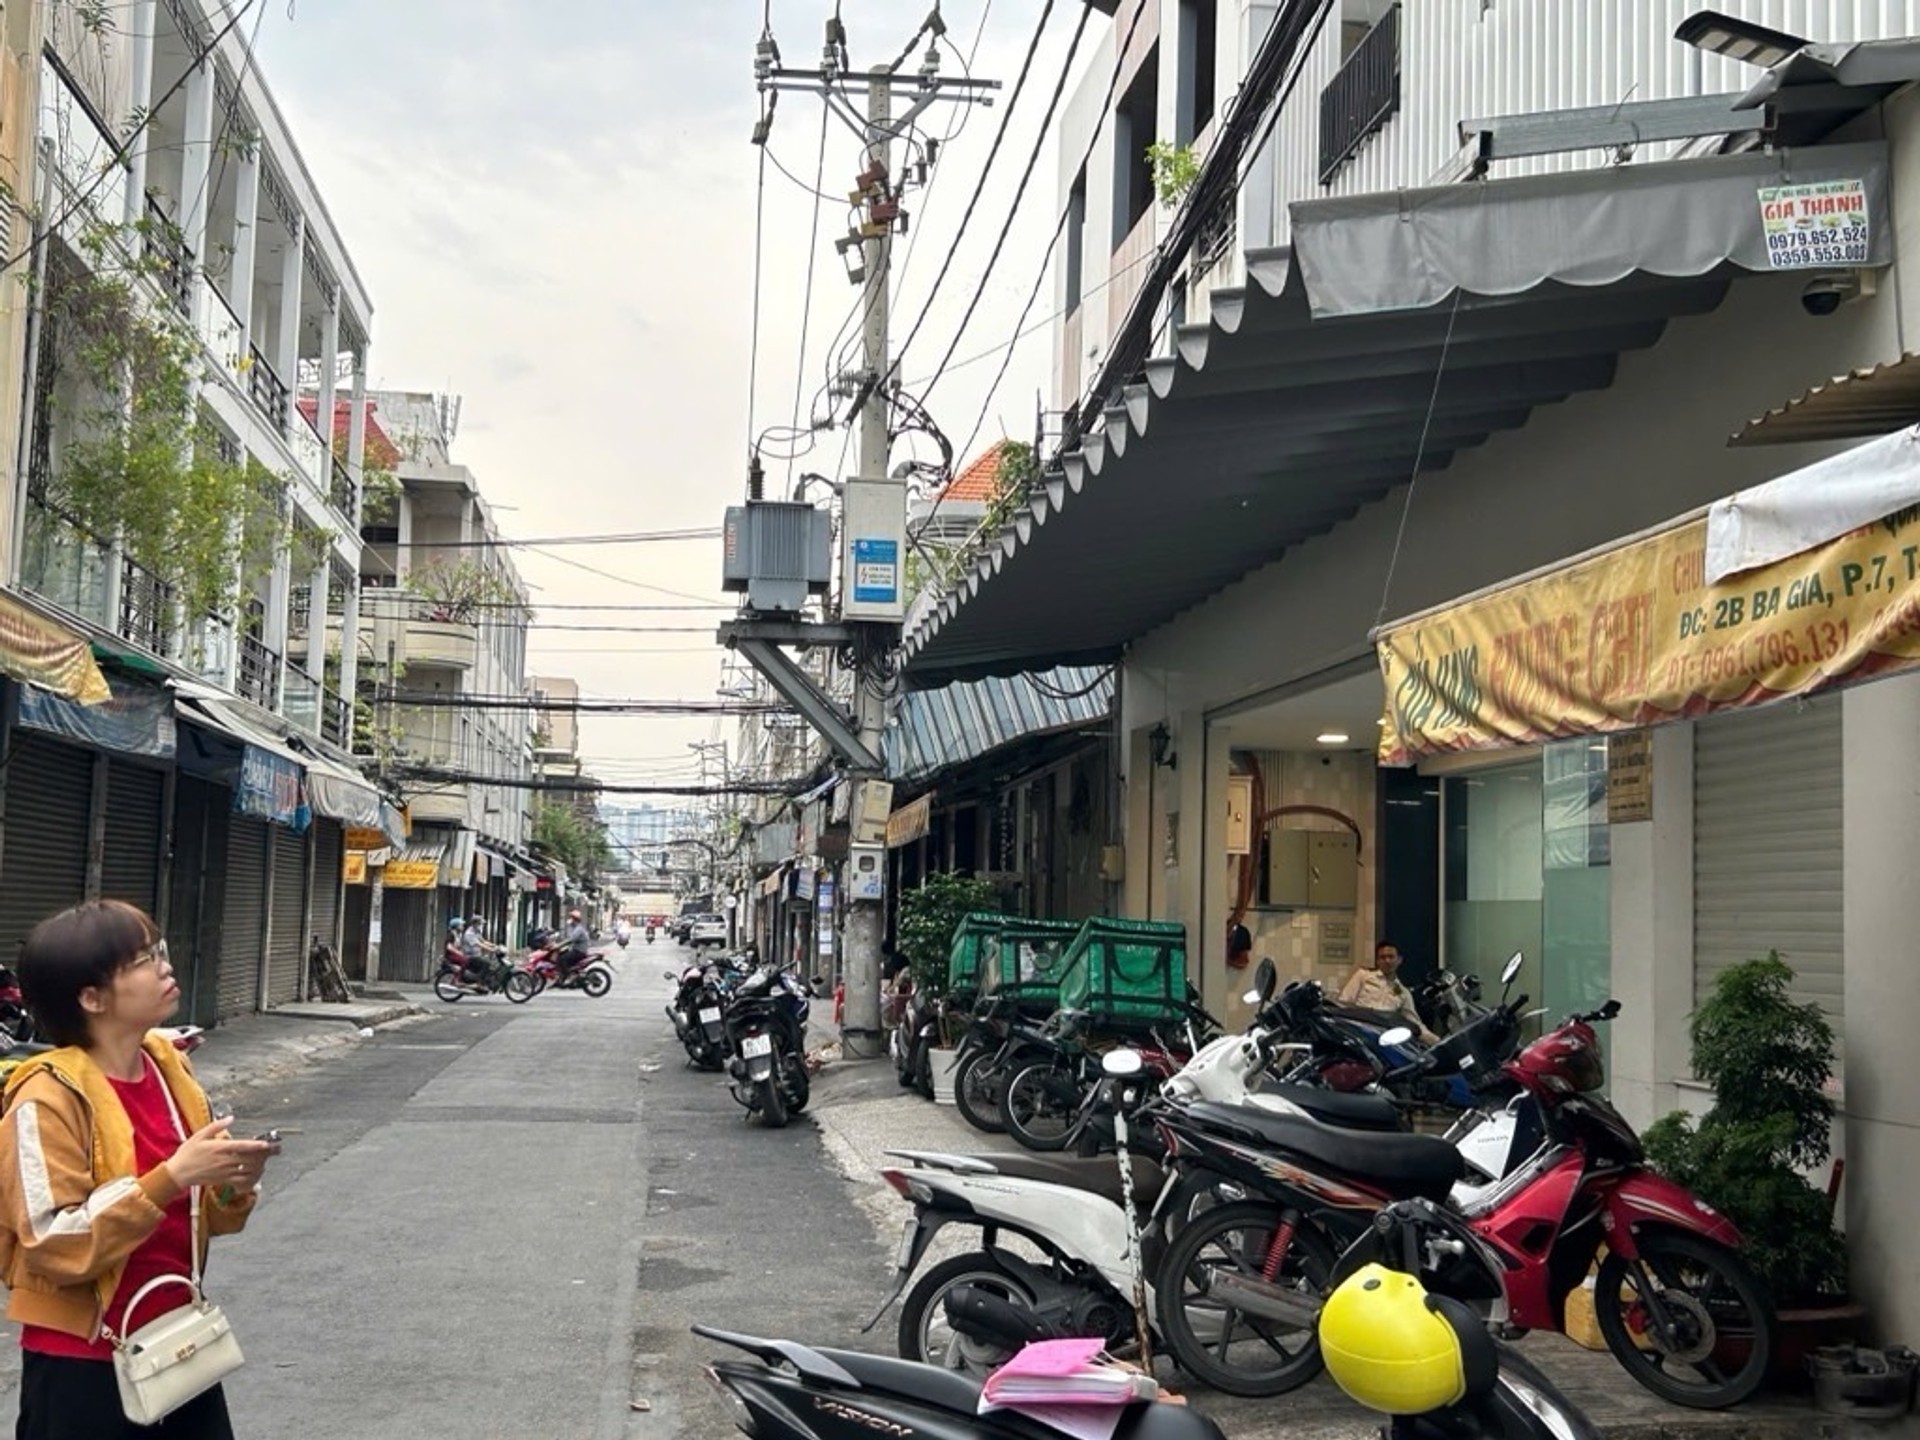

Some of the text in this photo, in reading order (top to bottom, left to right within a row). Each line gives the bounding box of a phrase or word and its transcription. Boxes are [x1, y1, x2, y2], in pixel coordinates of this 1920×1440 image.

[1765, 201, 1794, 219] GIA
[1714, 596, 1745, 630] 2B
[1751, 586, 1781, 622] BA
[1842, 555, 1895, 597] P.7,
[1700, 618, 1850, 683] 0961.796.131
